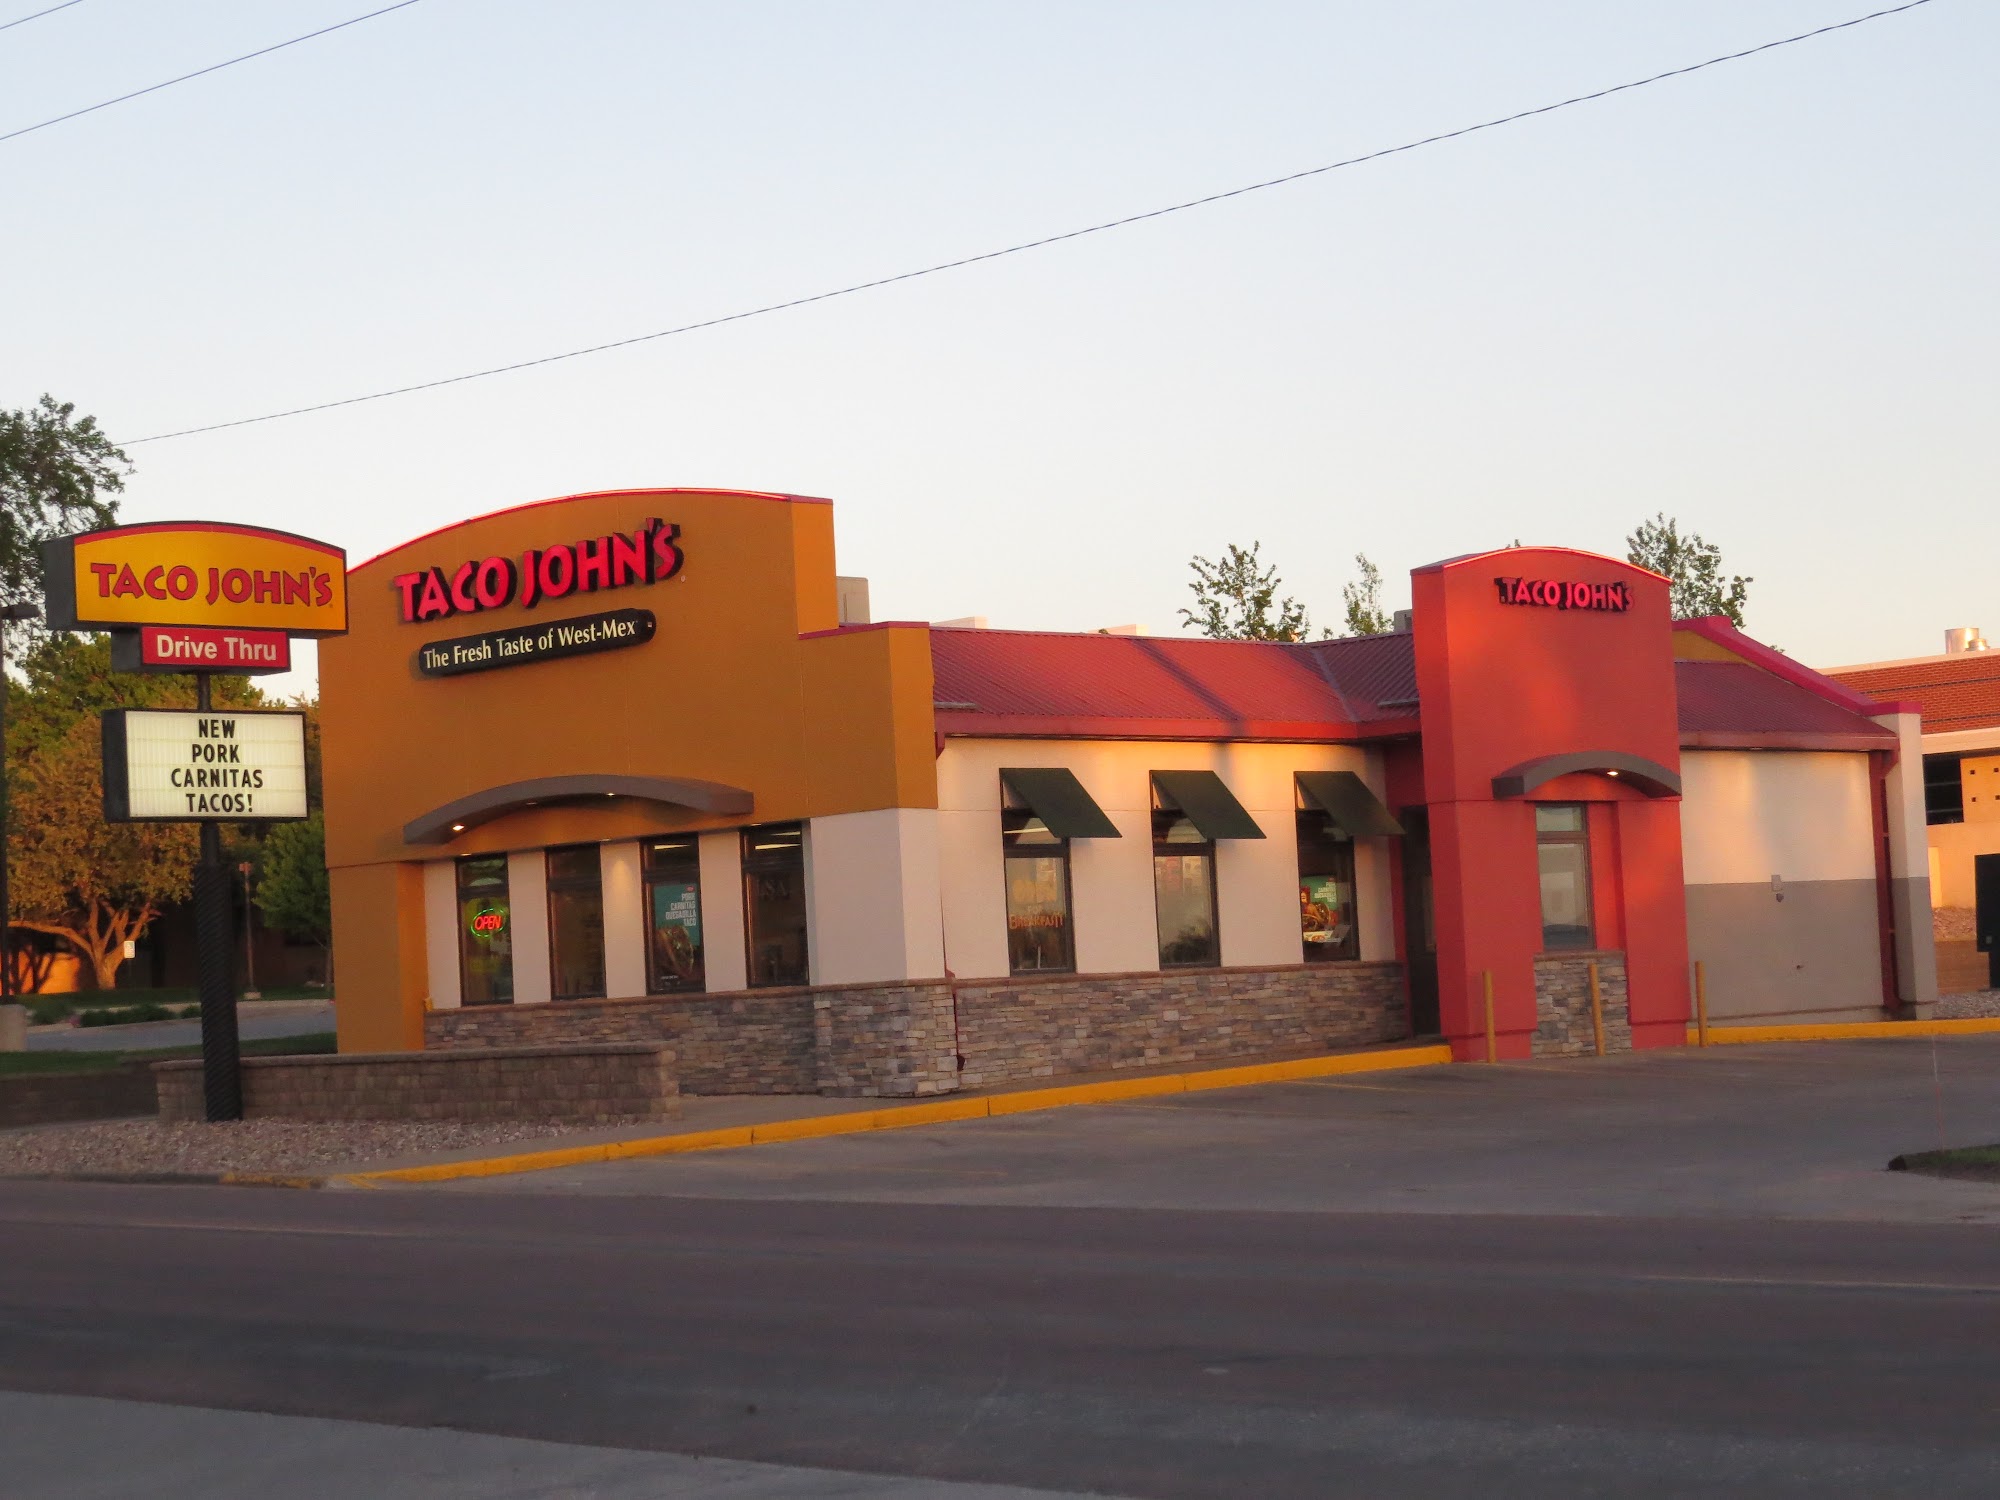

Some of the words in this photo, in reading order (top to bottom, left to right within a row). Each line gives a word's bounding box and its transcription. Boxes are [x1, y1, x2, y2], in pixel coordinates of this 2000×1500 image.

[393, 551, 517, 622] TACO
[520, 516, 684, 608] JOHN'S
[90, 563, 198, 600] TACO
[206, 566, 333, 607] JOHN'S
[1494, 577, 1561, 606] TACO
[156, 635, 218, 659] Drive
[224, 637, 277, 661] Thru
[424, 649, 450, 669] The
[453, 639, 492, 665] Fresh
[496, 636, 534, 658] Taste
[538, 628, 554, 651] of
[557, 619, 636, 647] West-Mex
[198, 719, 236, 738] NEW
[192, 743, 241, 763] PORK
[171, 768, 264, 789] CARNITAS
[185, 793, 253, 813] TACOS!
[475, 915, 502, 930] OPEN
